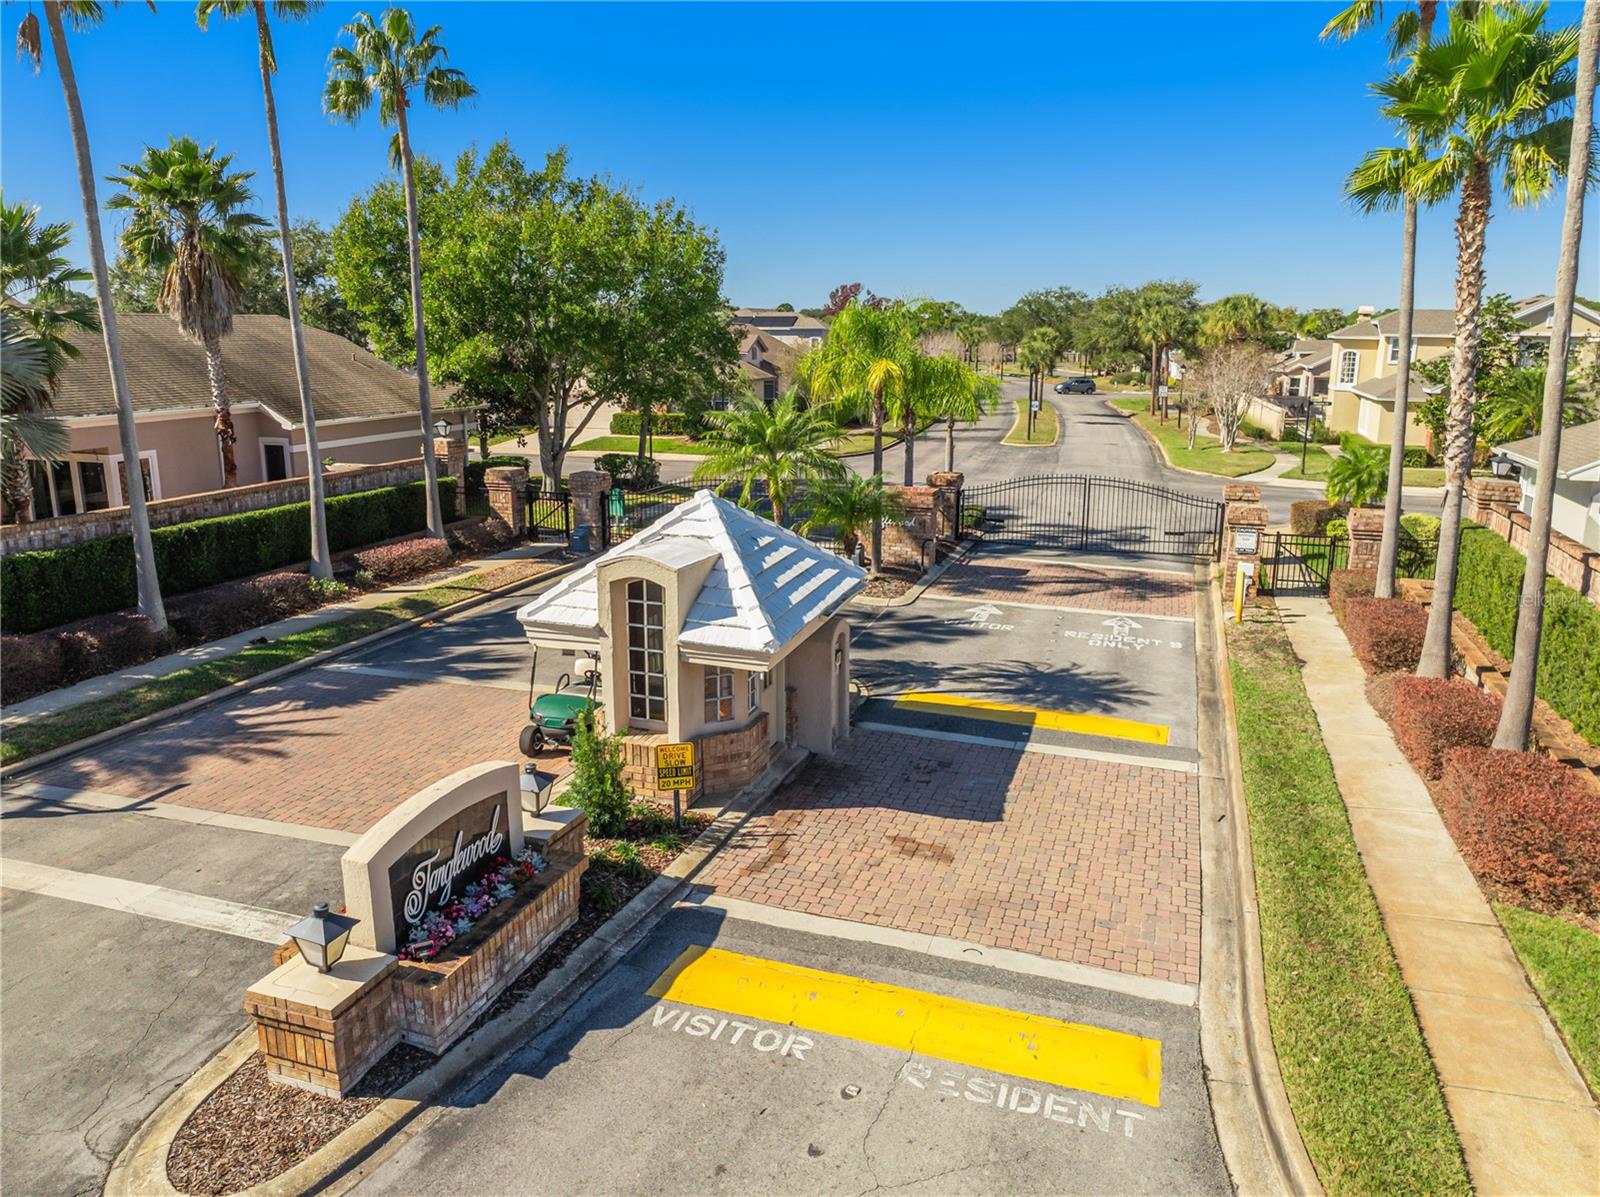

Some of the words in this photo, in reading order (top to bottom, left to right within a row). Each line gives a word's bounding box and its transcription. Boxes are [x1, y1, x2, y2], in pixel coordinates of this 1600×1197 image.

[1088, 639, 1145, 650] ONLY
[662, 752, 687, 760] DRIVE
[664, 759, 687, 767] SLOW
[659, 767, 676, 778] SPEED
[677, 766, 692, 777] LIMIT
[672, 778, 691, 786] MPH
[404, 804, 503, 923] Tanglewood
[652, 1005, 815, 1061] VISITOR
[899, 1062, 1146, 1138] RESIDENT
